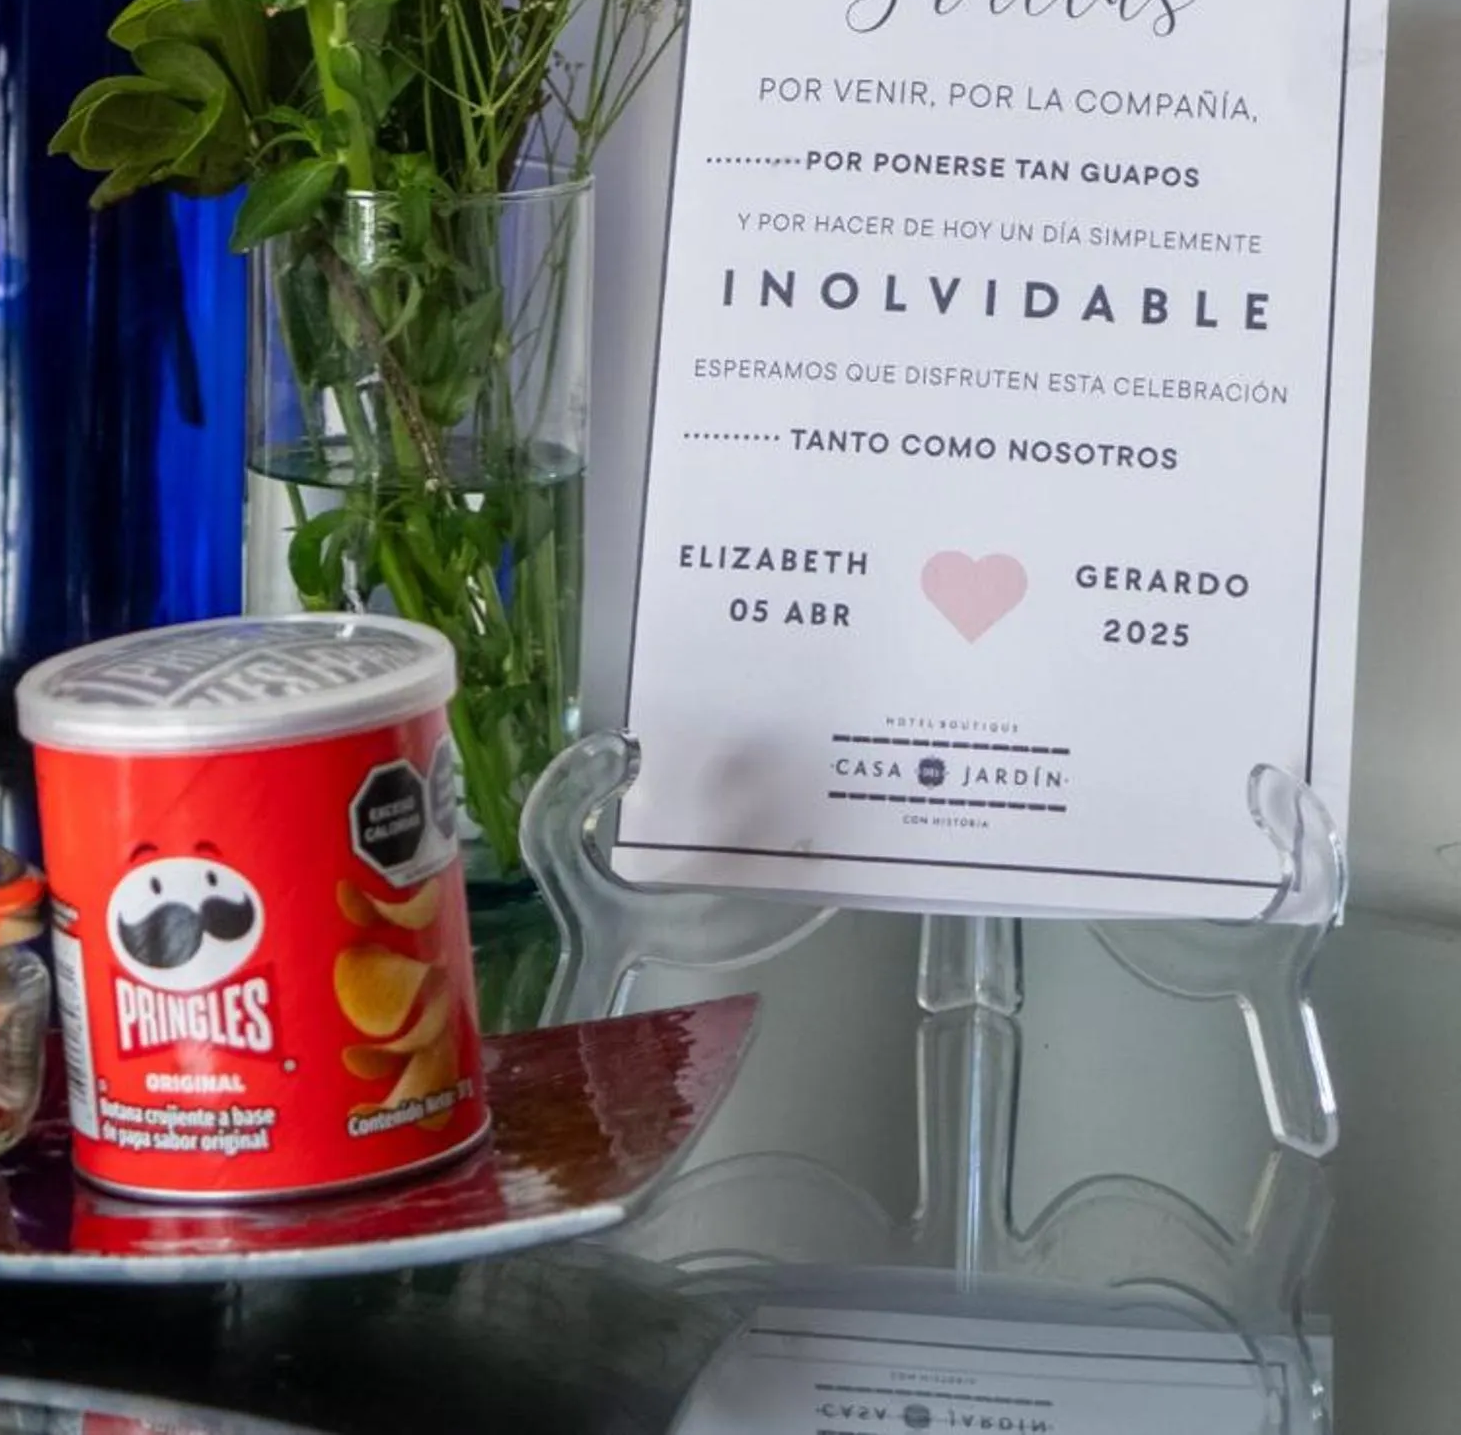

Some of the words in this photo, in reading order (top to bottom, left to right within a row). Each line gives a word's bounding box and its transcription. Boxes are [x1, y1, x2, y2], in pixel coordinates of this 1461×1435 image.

[759, 77, 822, 103] POR
[833, 78, 936, 108] VENIR,
[948, 82, 1014, 109] POR
[1027, 86, 1064, 112] LA
[1074, 88, 1258, 123] COMPAÑÍA,
[806, 150, 863, 172] POR
[873, 152, 1006, 179] PONERSE
[1015, 158, 1070, 182] TAN
[1080, 162, 1200, 189] GUAPOS
[737, 212, 751, 231] Y
[757, 212, 806, 233] POR
[814, 215, 895, 236] HACER
[903, 217, 934, 237] DE
[943, 220, 993, 240] HOY
[1000, 222, 1034, 242] UN
[1042, 221, 1082, 245] DÍA
[1088, 226, 1262, 254] SIMPLEMENTE
[723, 268, 1269, 331] INOLVIDABLE
[694, 358, 838, 382] ESPERAMOS
[845, 362, 897, 384] QUE
[905, 365, 1039, 391] DISFRUTEN
[1047, 372, 1106, 395] ESTA
[1113, 376, 1288, 405] CELEBRACIÓN
[790, 428, 890, 455] TANTO
[900, 433, 997, 460] COMO
[1008, 438, 1178, 471] NOSOTROS
[679, 544, 868, 576] ELIZABETH
[1075, 564, 1249, 599] GERARDO
[729, 598, 769, 623] 05
[783, 600, 850, 628] ABR
[1103, 618, 1189, 648] 2025
[834, 758, 901, 778] CASA
[961, 765, 1062, 788] JARDÍN
[114, 976, 274, 1053] PRINGLES
[145, 1072, 246, 1094] ORIGINAL
[218, 1110, 230, 1126] a
[231, 1106, 276, 1126] base
[153, 1126, 198, 1151] sabor
[200, 1127, 269, 1156] original
